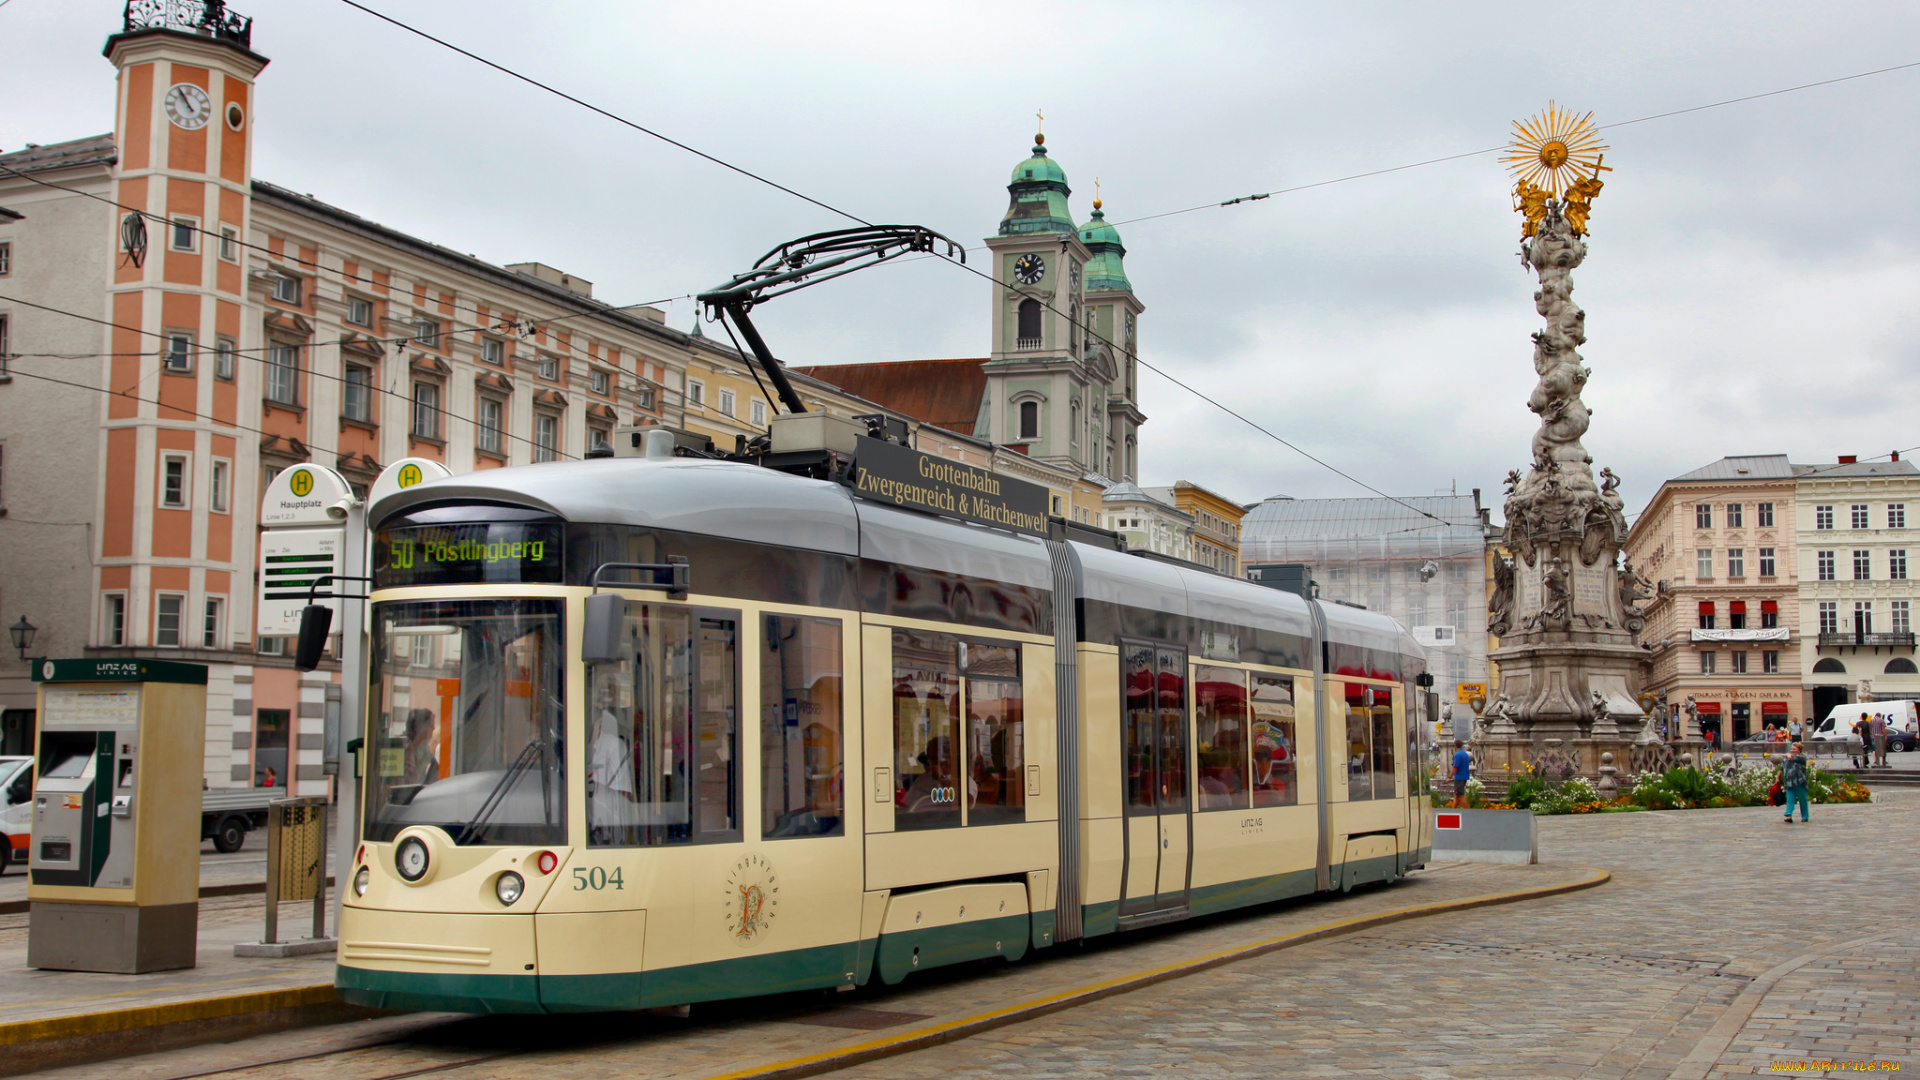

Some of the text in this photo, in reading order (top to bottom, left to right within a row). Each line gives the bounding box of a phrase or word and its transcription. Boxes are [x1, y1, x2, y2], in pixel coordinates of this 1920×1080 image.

[296, 474, 308, 492] H
[918, 455, 1000, 496] Grottenbahn
[280, 500, 322, 510] Hauptplatz
[857, 466, 1048, 534] Zwergenreich & Märchenwelt
[391, 537, 544, 569] 50 Pöstlingberg
[96, 663, 137, 671] LINZ AG
[1241, 818, 1263, 828] LINZ AG
[573, 866, 624, 891] 504
